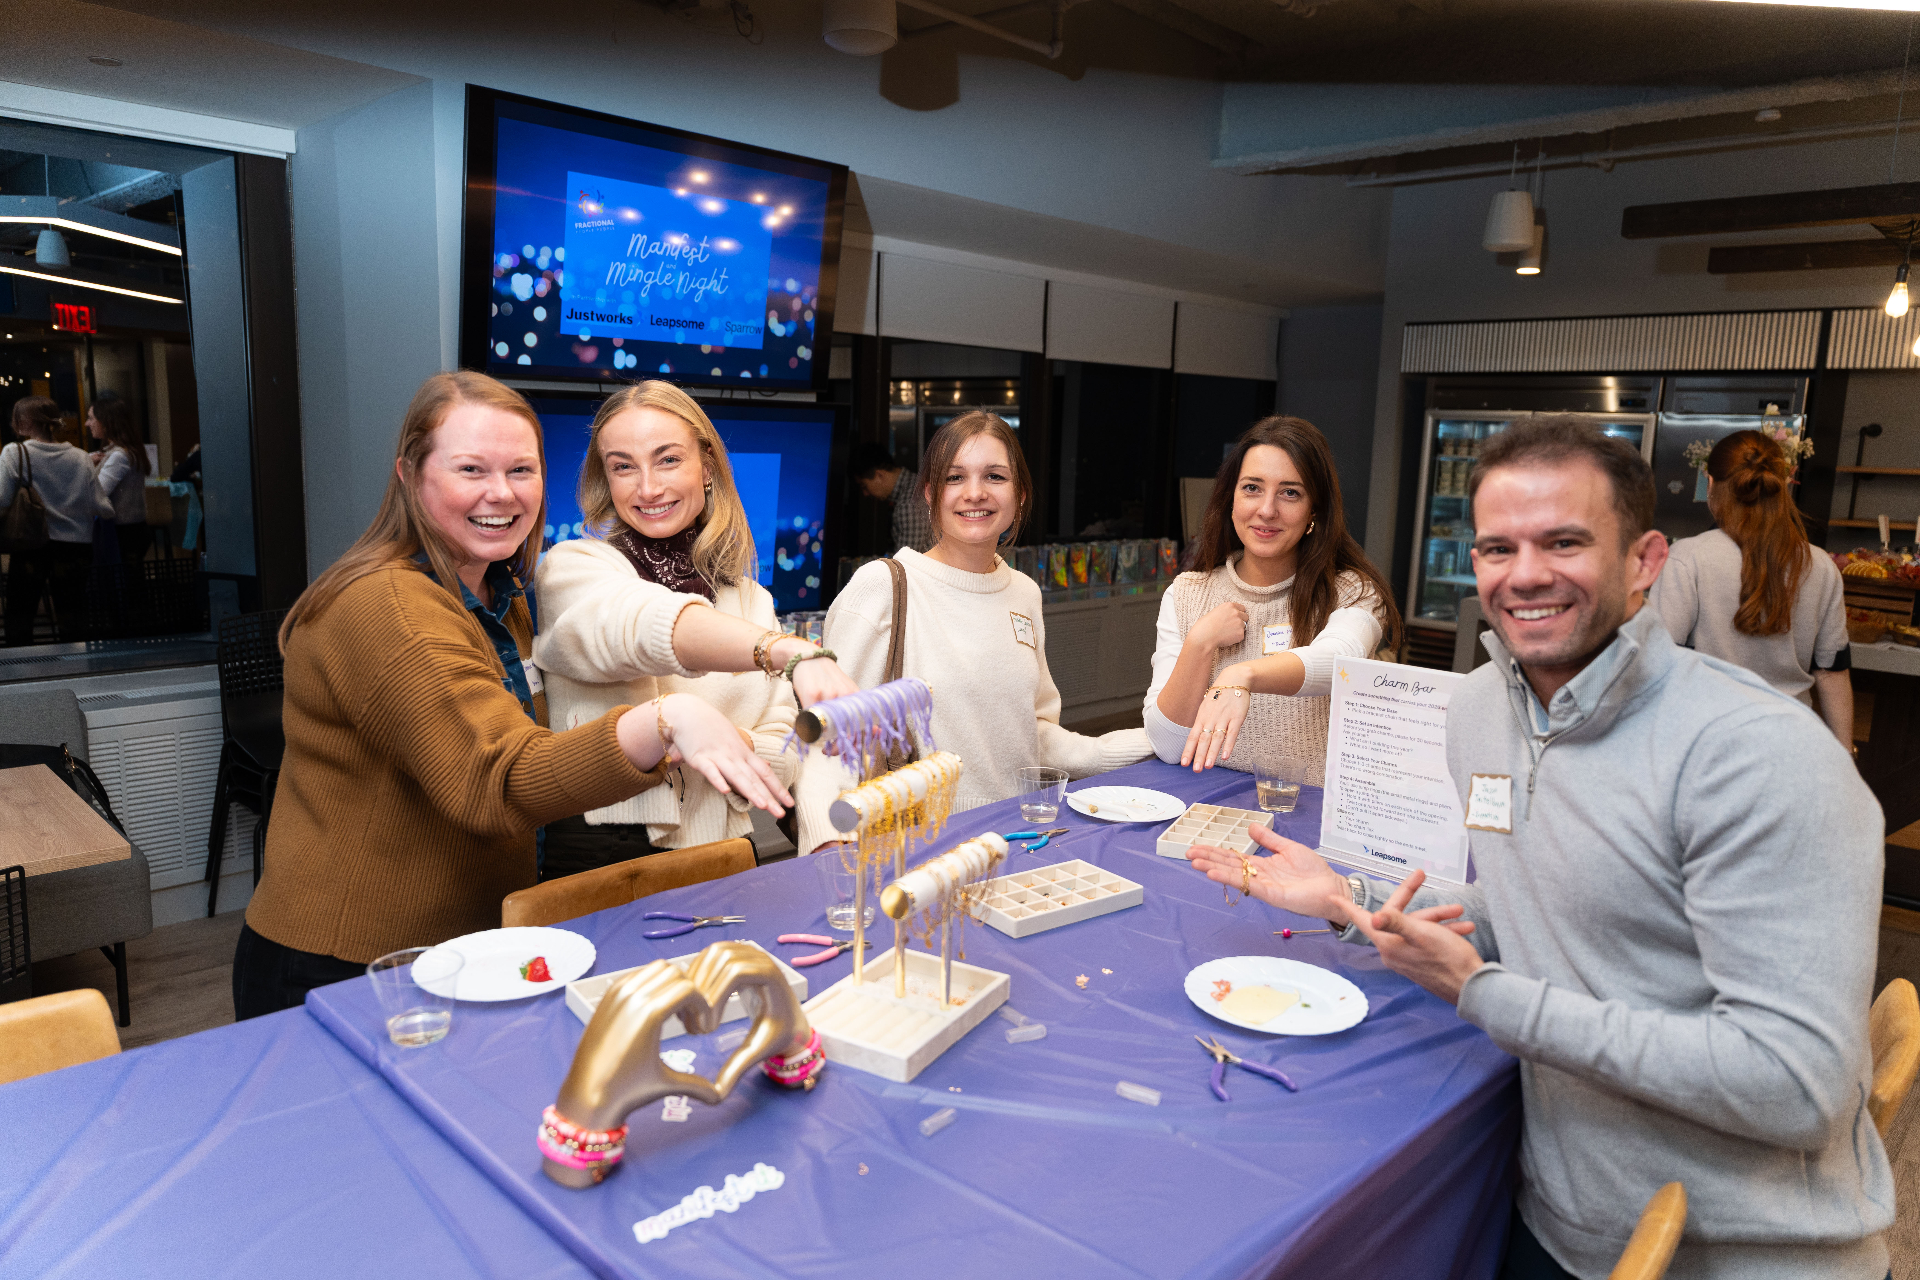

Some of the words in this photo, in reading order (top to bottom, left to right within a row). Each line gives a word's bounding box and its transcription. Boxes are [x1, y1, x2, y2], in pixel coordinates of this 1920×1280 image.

[574, 220, 614, 229] FRACTIONAL
[626, 232, 710, 266] Manifest
[606, 261, 676, 298] Mingle
[676, 268, 728, 302] Night
[566, 308, 633, 324] Justworks
[650, 314, 705, 330] Leapsome
[725, 321, 762, 334] Sparrow
[1374, 674, 1408, 692] Charm
[1411, 682, 1436, 696] Bar
[1371, 849, 1408, 865] Leapsome
